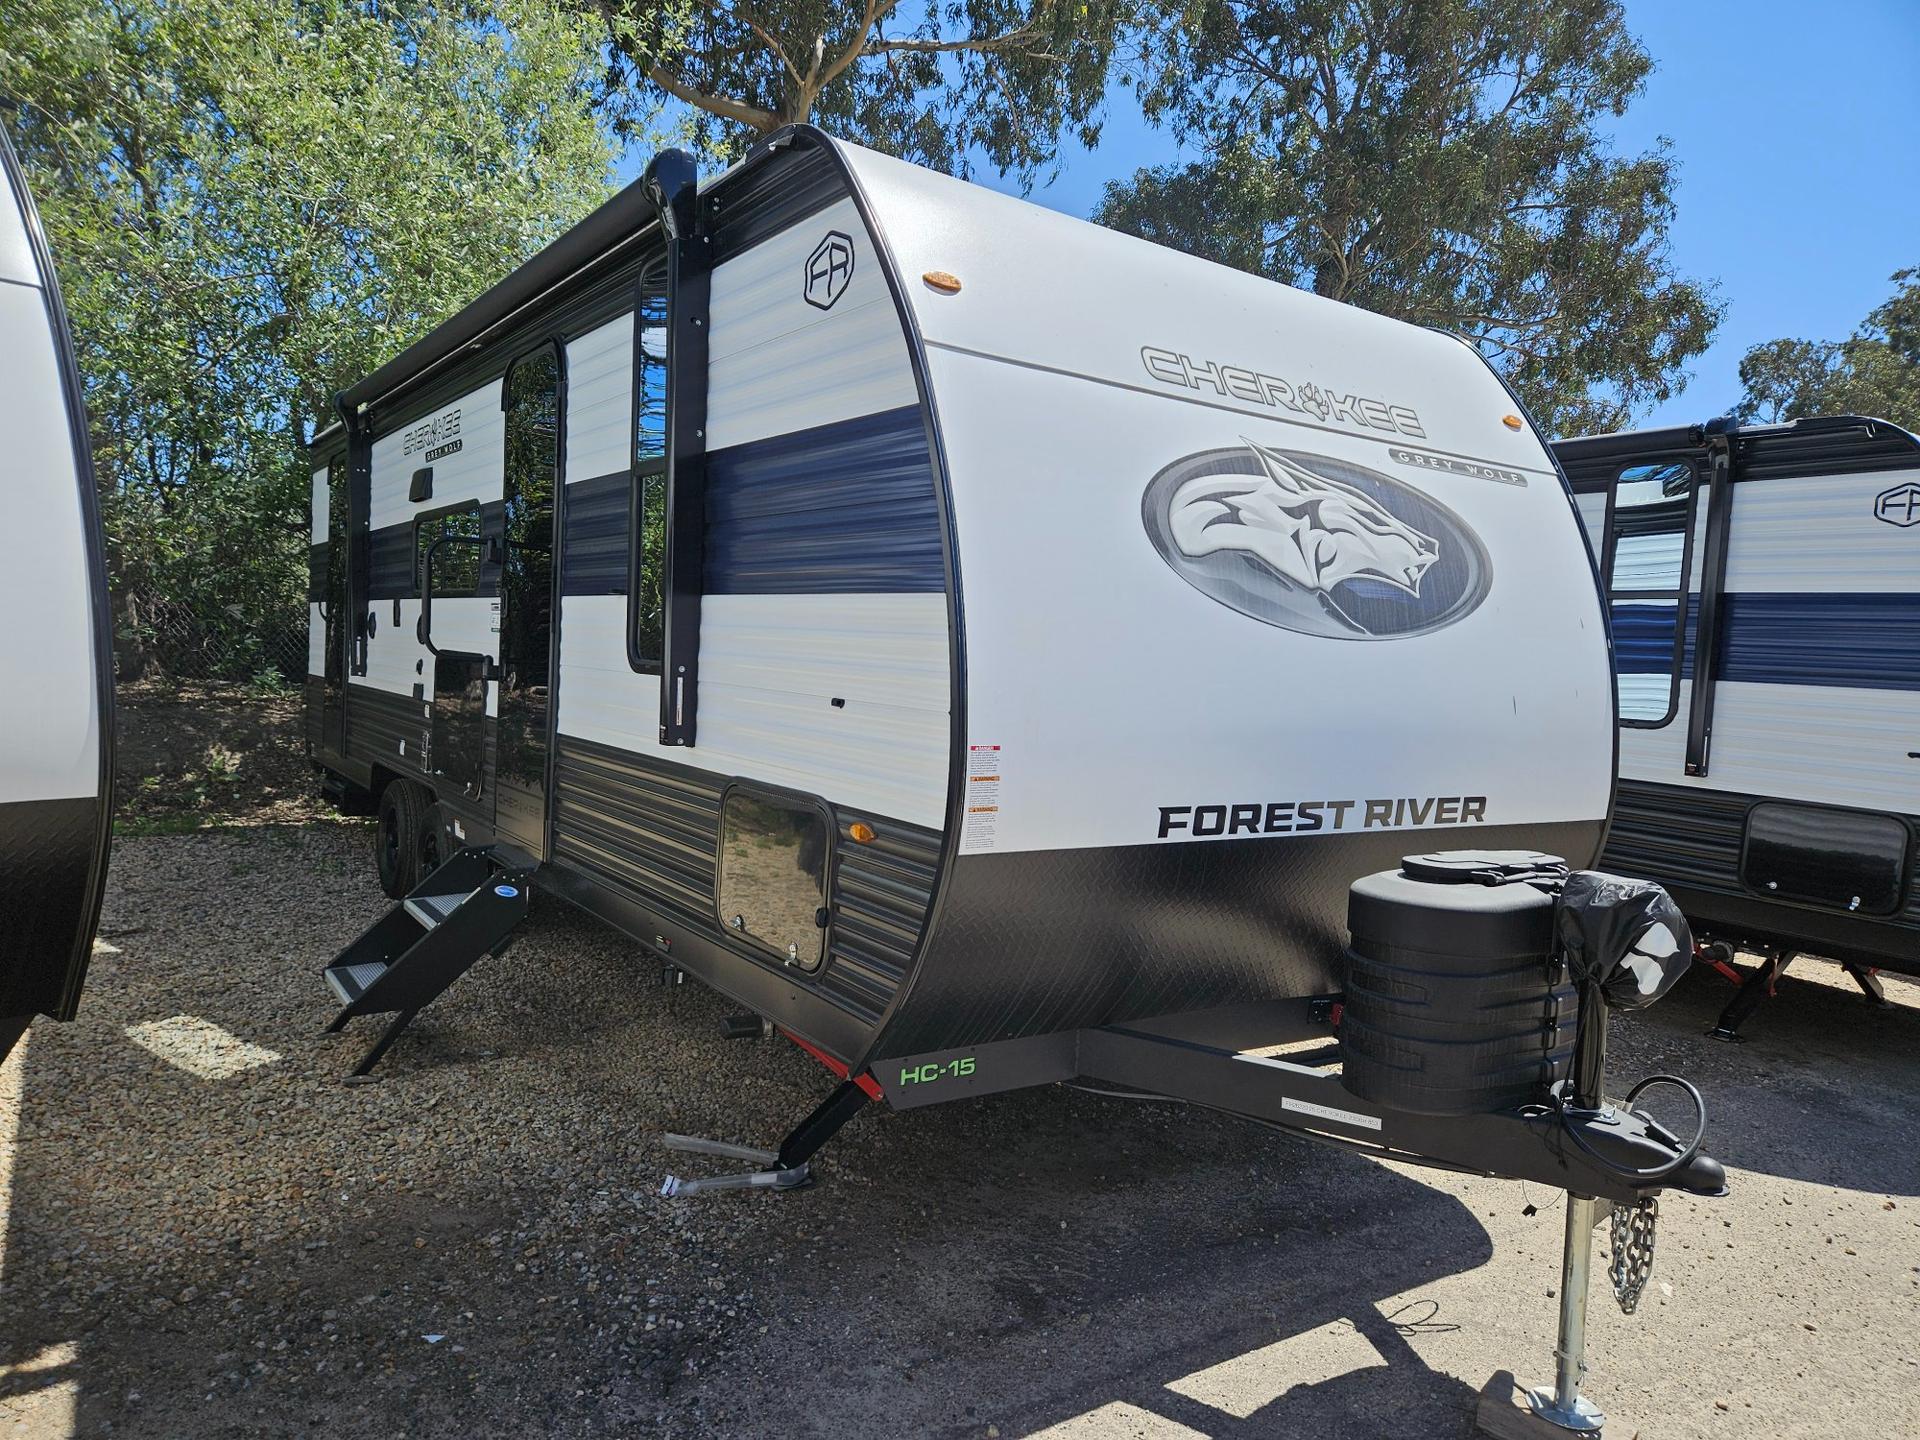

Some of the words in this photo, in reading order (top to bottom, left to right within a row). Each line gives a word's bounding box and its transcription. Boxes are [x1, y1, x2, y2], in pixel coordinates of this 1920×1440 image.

[1398, 452, 1453, 470] GREY
[1465, 464, 1520, 483] WOLF
[1157, 800, 1355, 839] FOREST
[1363, 796, 1487, 828] RIVER
[900, 1057, 977, 1086] HC-15
